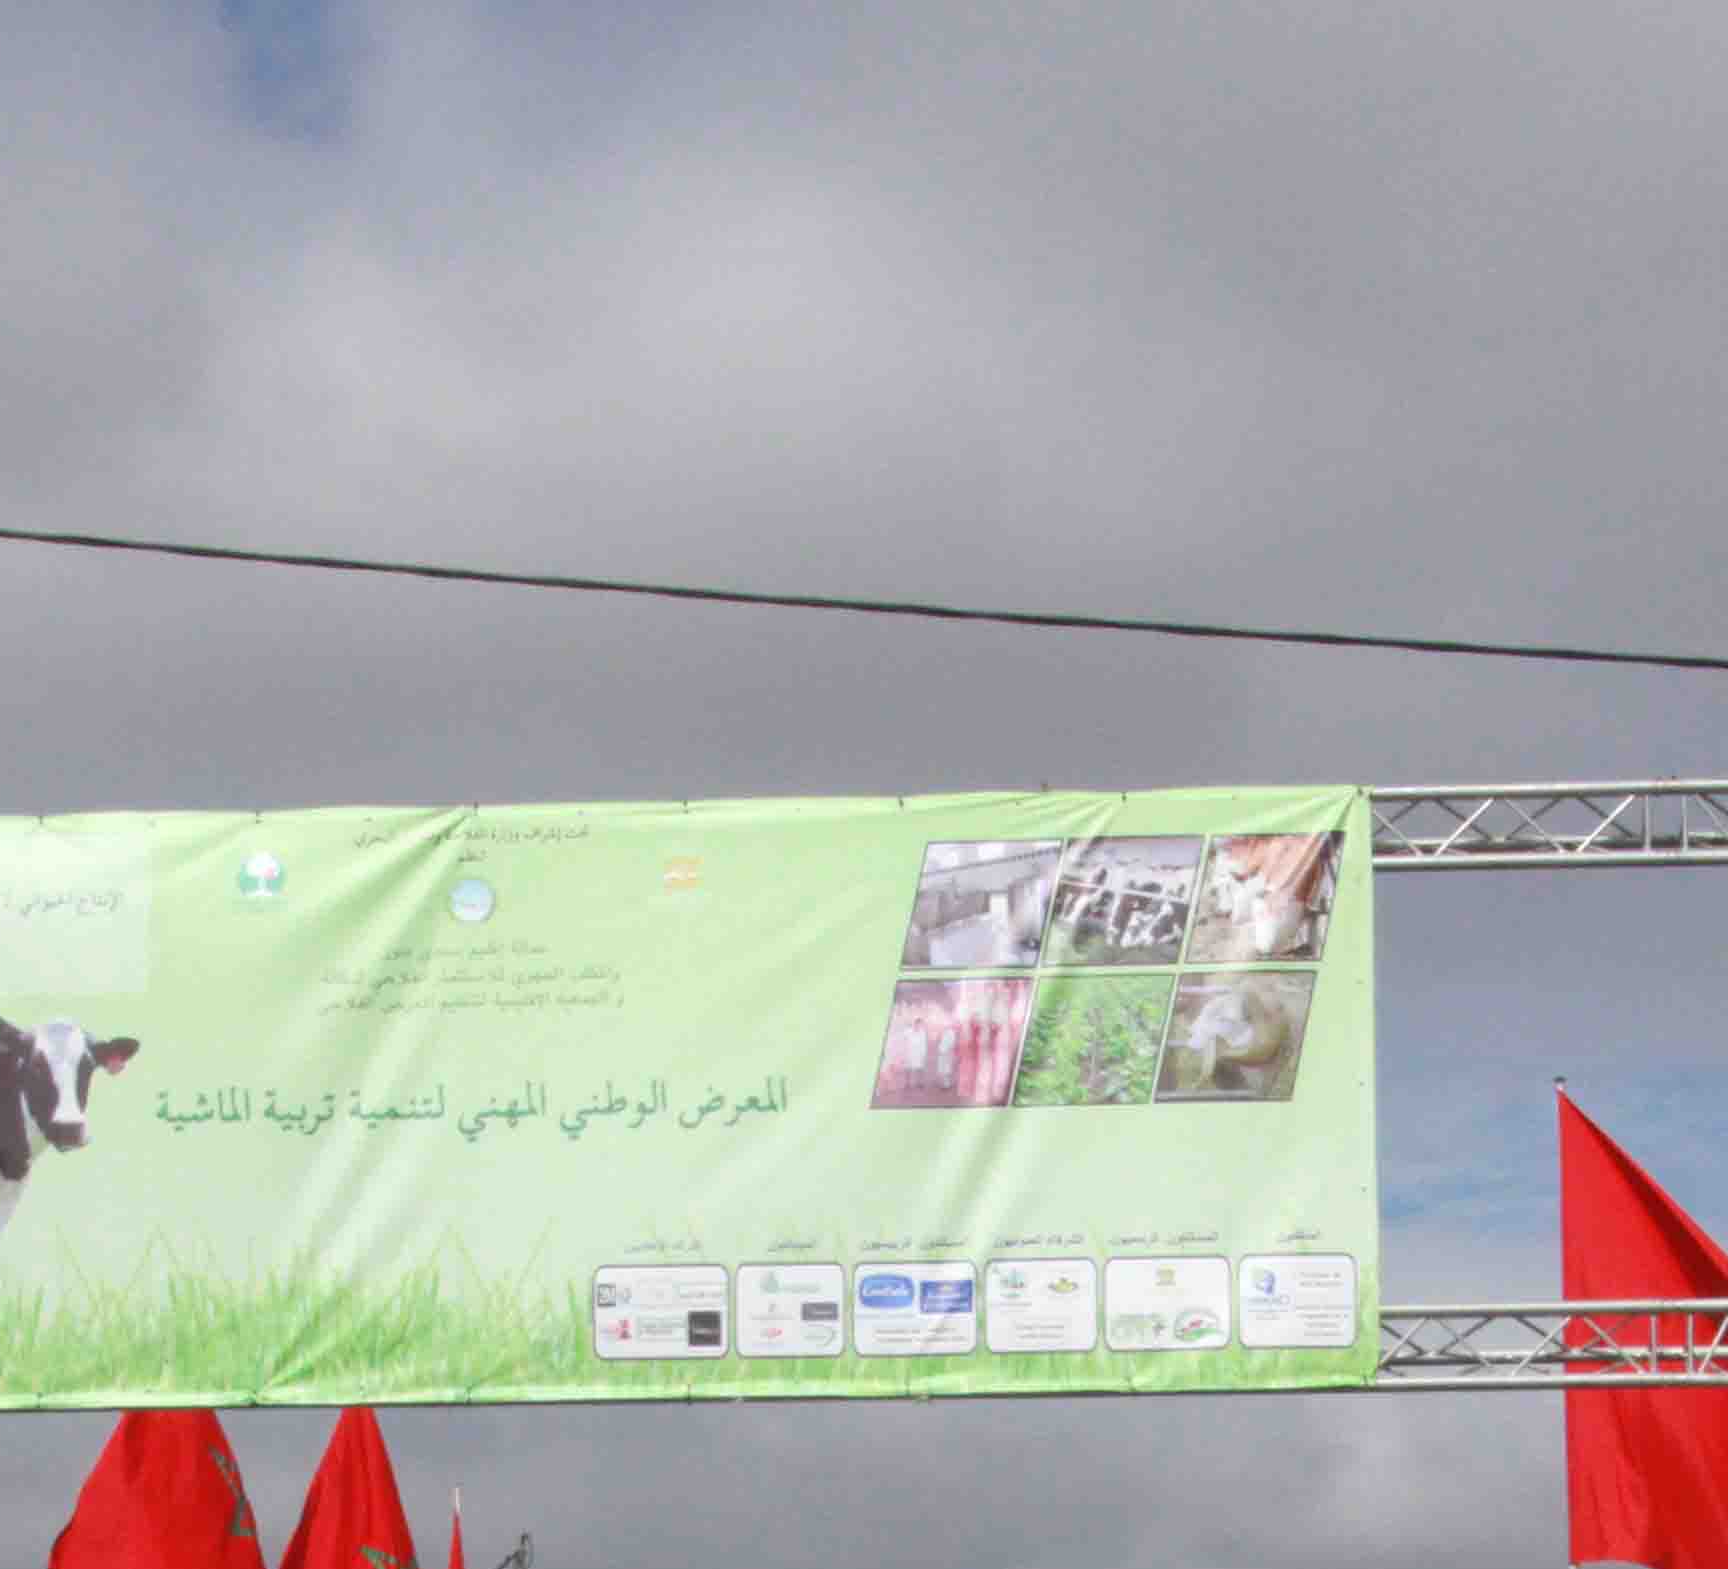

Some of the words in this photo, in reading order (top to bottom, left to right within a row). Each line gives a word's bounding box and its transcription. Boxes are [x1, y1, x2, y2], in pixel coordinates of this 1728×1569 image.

[156, 1084, 252, 1132] الماشية
[263, 1089, 336, 1135] تربية
[348, 1082, 446, 1129] لتنمية
[457, 1080, 547, 1142] المهني
[559, 1079, 667, 1141] الوطني
[678, 1074, 786, 1129] المعرض
